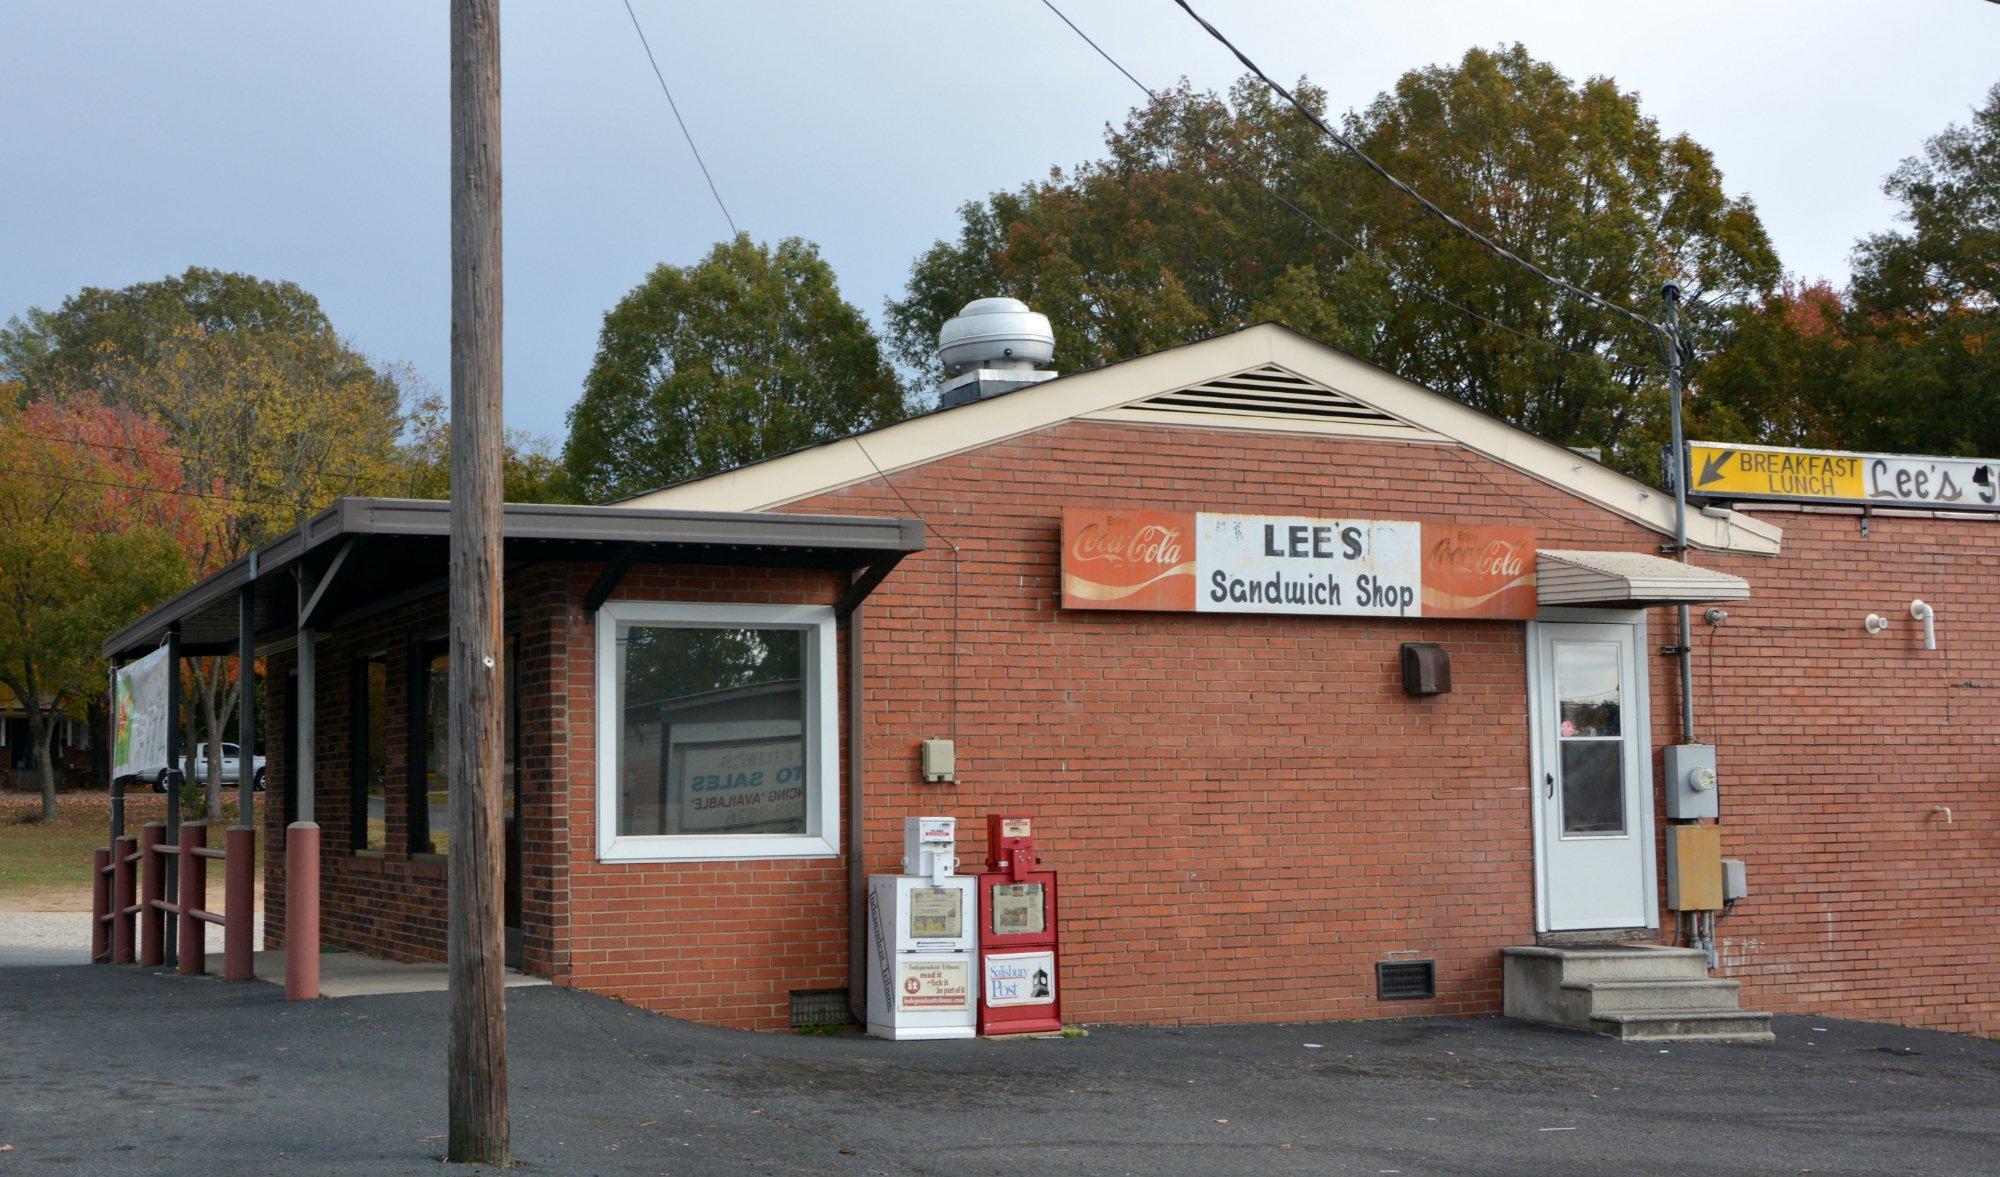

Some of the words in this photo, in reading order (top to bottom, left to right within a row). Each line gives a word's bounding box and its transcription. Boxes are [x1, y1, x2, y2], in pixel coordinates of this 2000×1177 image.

[1740, 453, 1858, 477] BREAKFAST
[1769, 474, 1835, 495] LUNCH
[1869, 460, 1962, 500] Lee's
[1264, 522, 1363, 560] LEE'S
[1210, 570, 1341, 605] Sandwich
[1356, 574, 1413, 616] Shop
[991, 965, 1028, 977] Salisbury
[992, 980, 1018, 997] Post
